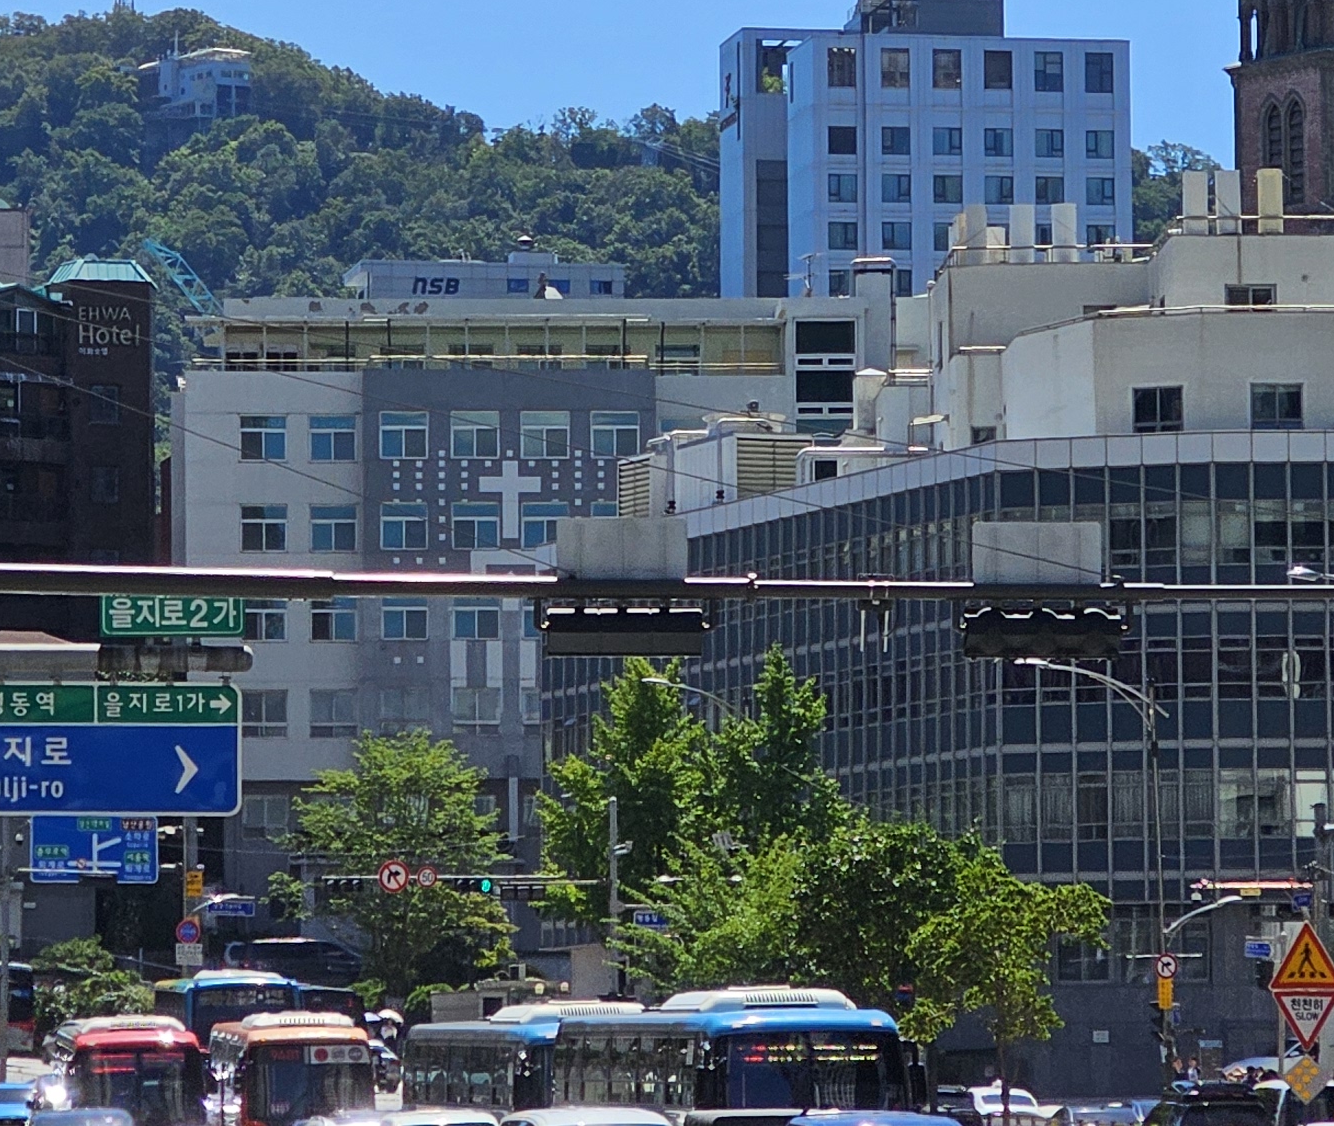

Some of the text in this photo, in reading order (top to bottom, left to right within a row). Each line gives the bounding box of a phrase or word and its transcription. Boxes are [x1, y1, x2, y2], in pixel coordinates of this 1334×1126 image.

[78, 306, 132, 321] EHWA
[78, 323, 140, 347] Hotel
[108, 597, 237, 629] 을지로2가
[103, 692, 206, 717] 을지로1가
[422, 872, 433, 883] 50
[1290, 998, 1324, 1011] 천천히
[1295, 1012, 1319, 1021] SLOW
